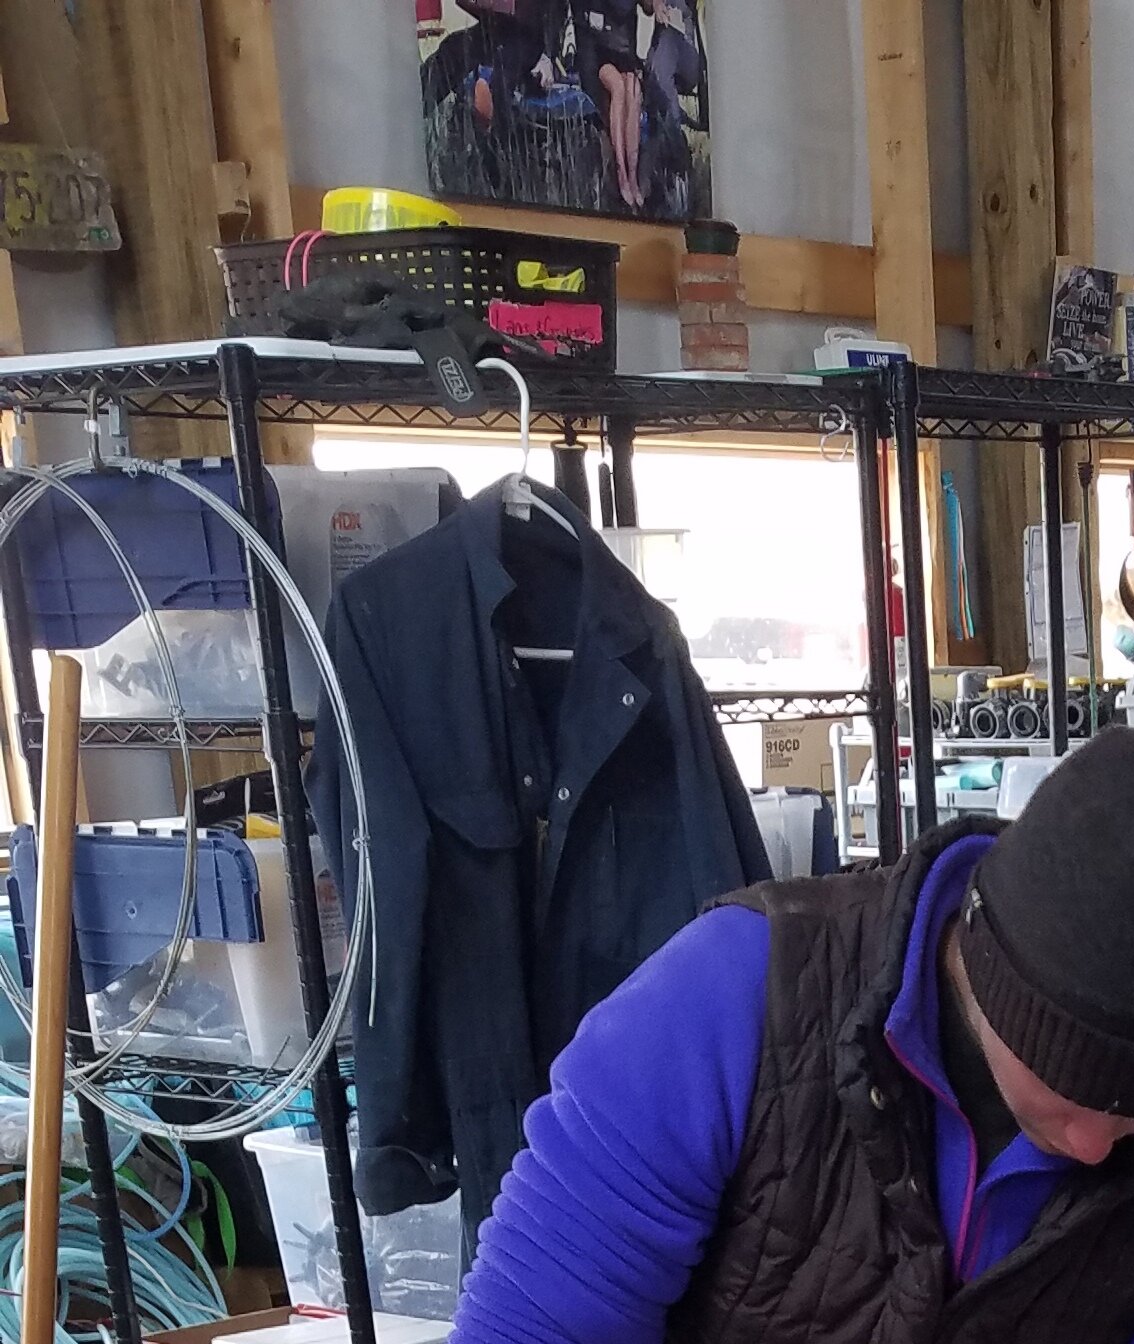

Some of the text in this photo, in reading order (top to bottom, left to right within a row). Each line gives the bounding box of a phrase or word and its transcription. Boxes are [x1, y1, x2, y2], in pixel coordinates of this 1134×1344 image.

[1080, 289, 1112, 309] POWER
[1062, 321, 1085, 339] LIVE
[332, 512, 361, 531] HDX
[765, 739, 800, 753] 916CD
